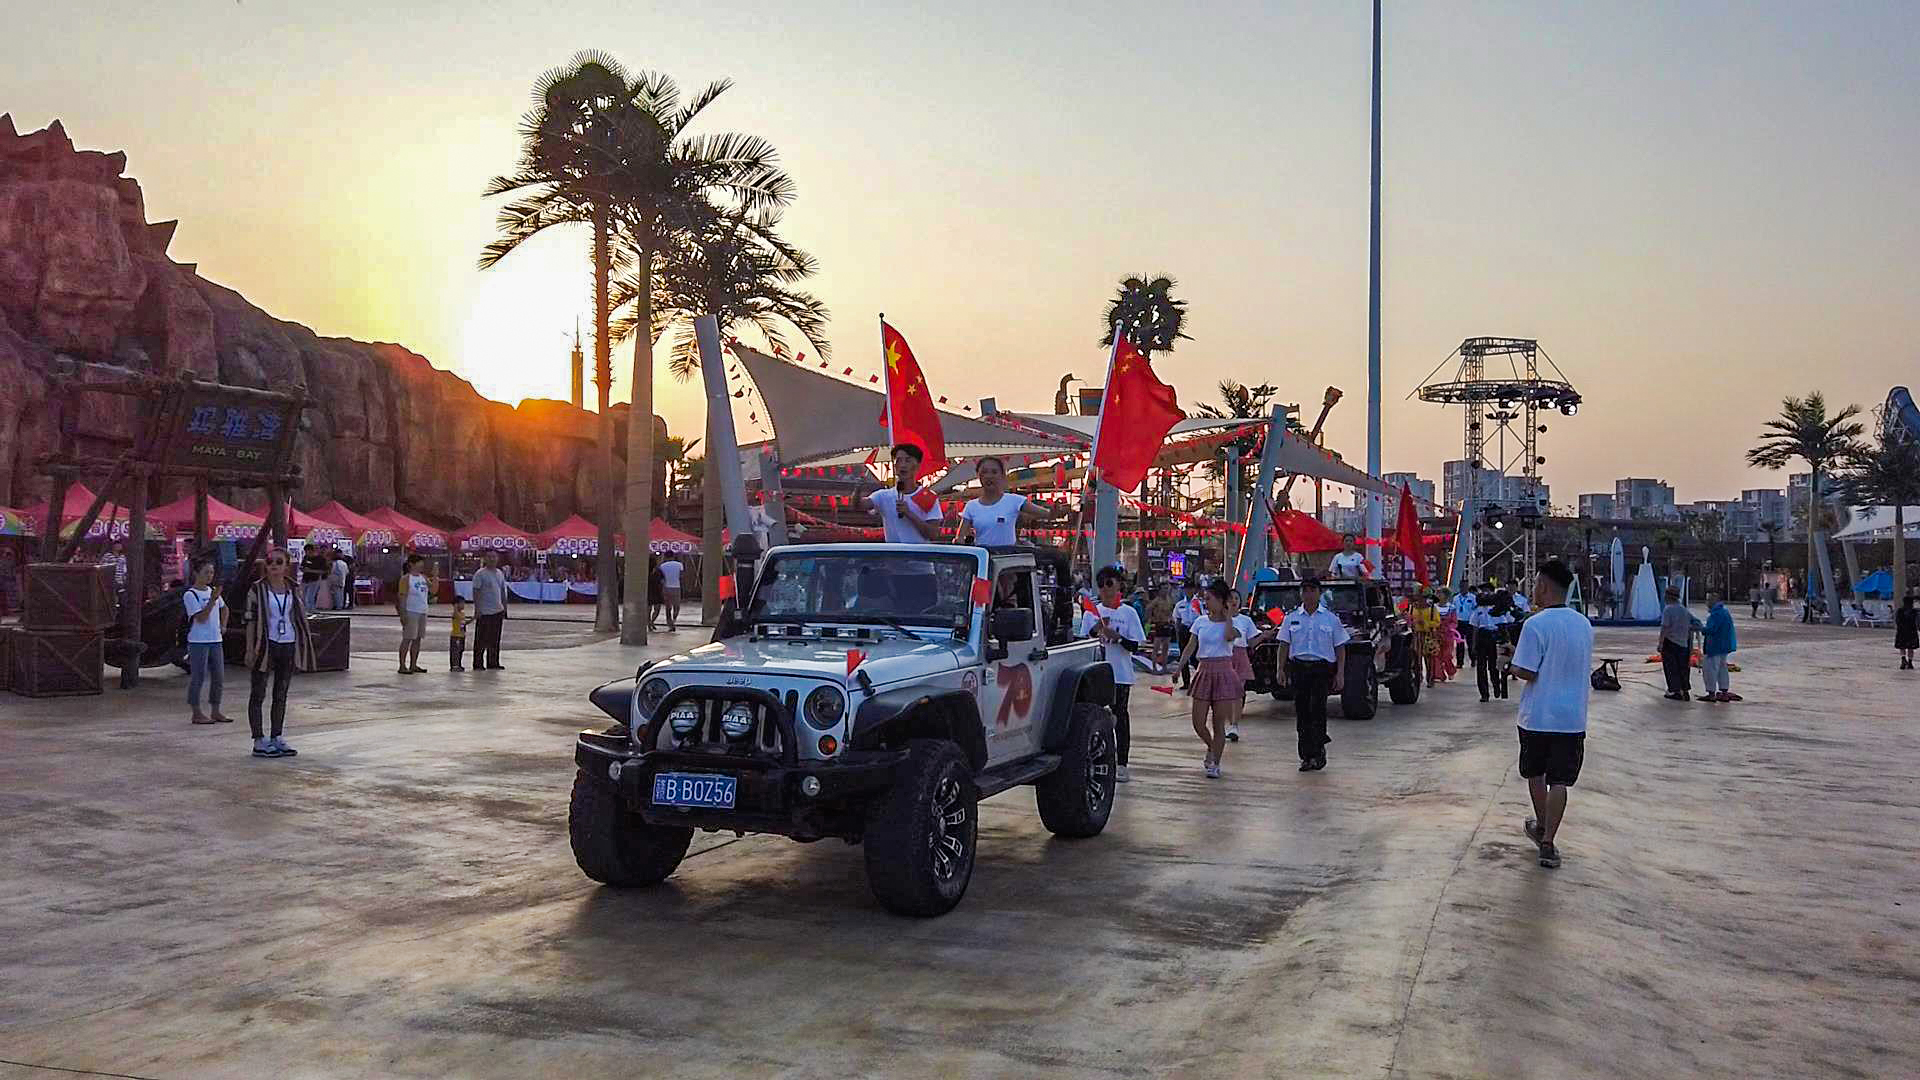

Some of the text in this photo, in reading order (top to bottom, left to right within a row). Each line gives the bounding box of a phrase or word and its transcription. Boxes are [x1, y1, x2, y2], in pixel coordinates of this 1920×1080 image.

[192, 445, 261, 460] MAYA BAY
[726, 675, 752, 685] Jeep
[670, 711, 695, 720] PIAA
[722, 714, 747, 724] PIAA
